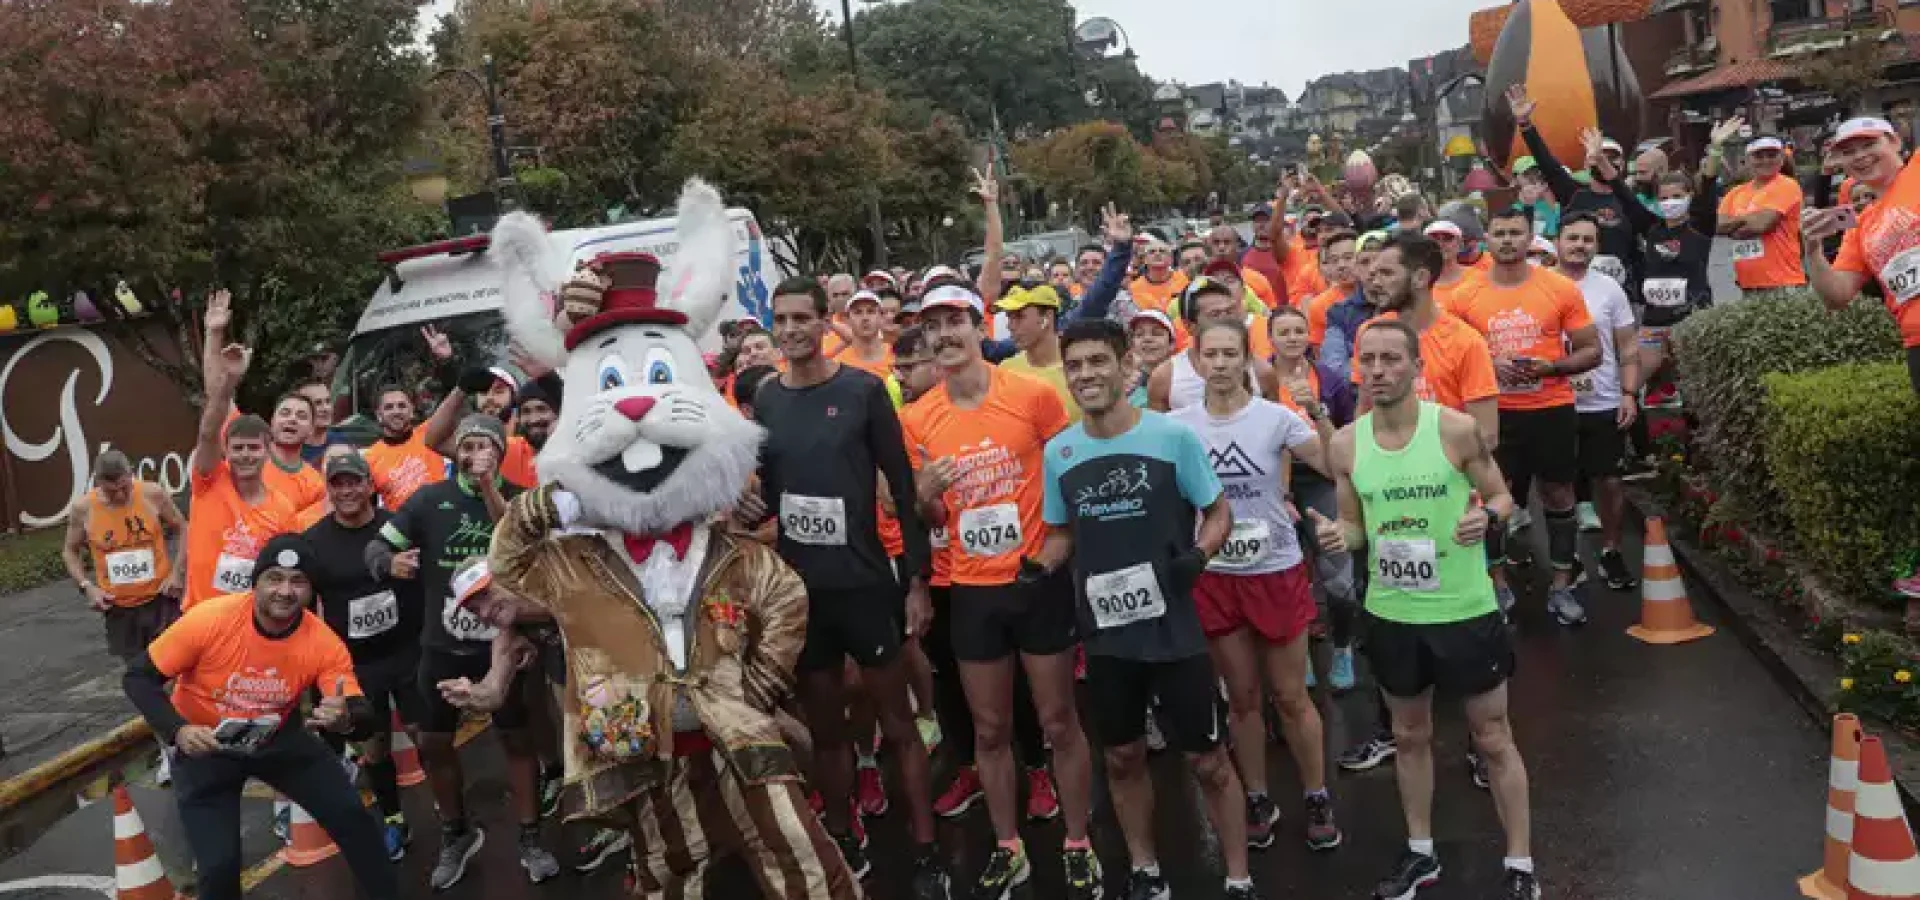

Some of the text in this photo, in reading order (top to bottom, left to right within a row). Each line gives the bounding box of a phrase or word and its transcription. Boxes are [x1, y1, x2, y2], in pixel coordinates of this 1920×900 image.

[1888, 268, 1918, 293] 407
[1648, 288, 1681, 300] 9059
[1382, 484, 1447, 502] VIDATIVA
[788, 514, 836, 535] 9050
[965, 523, 1018, 547] 9074
[1223, 538, 1260, 557] 009
[1380, 559, 1433, 579] 9040
[221, 571, 252, 588] 403
[1097, 587, 1153, 615] 9002
[352, 607, 393, 630] 9001
